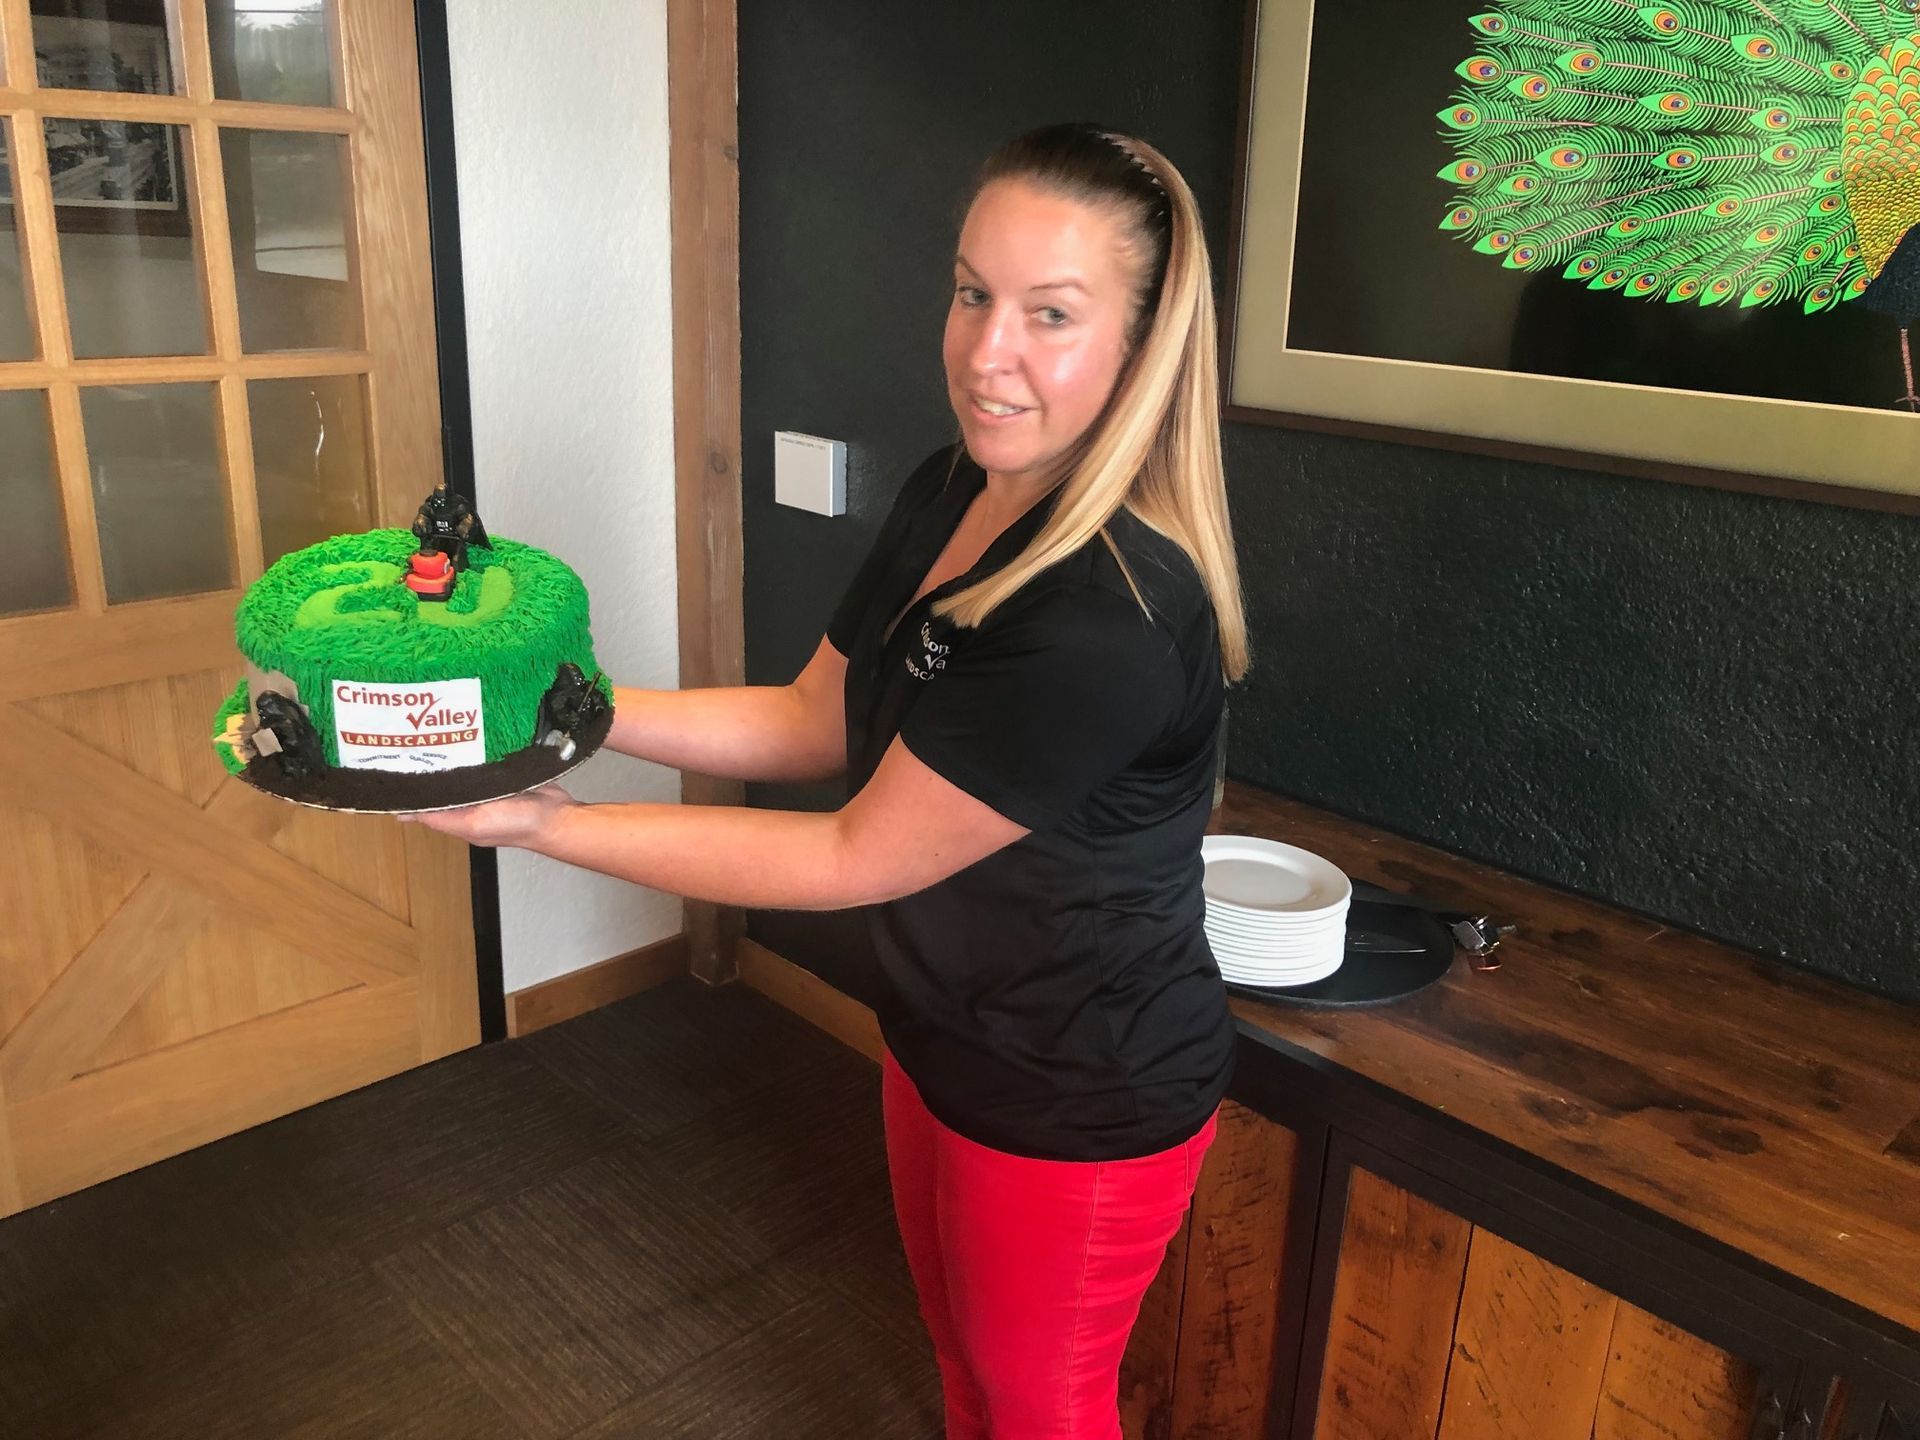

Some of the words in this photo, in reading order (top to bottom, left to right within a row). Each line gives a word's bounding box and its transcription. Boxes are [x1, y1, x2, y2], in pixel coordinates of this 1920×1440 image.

[336, 685, 434, 707] Crimson
[405, 699, 478, 731] Valley
[345, 730, 475, 747] LANDSCAPING
